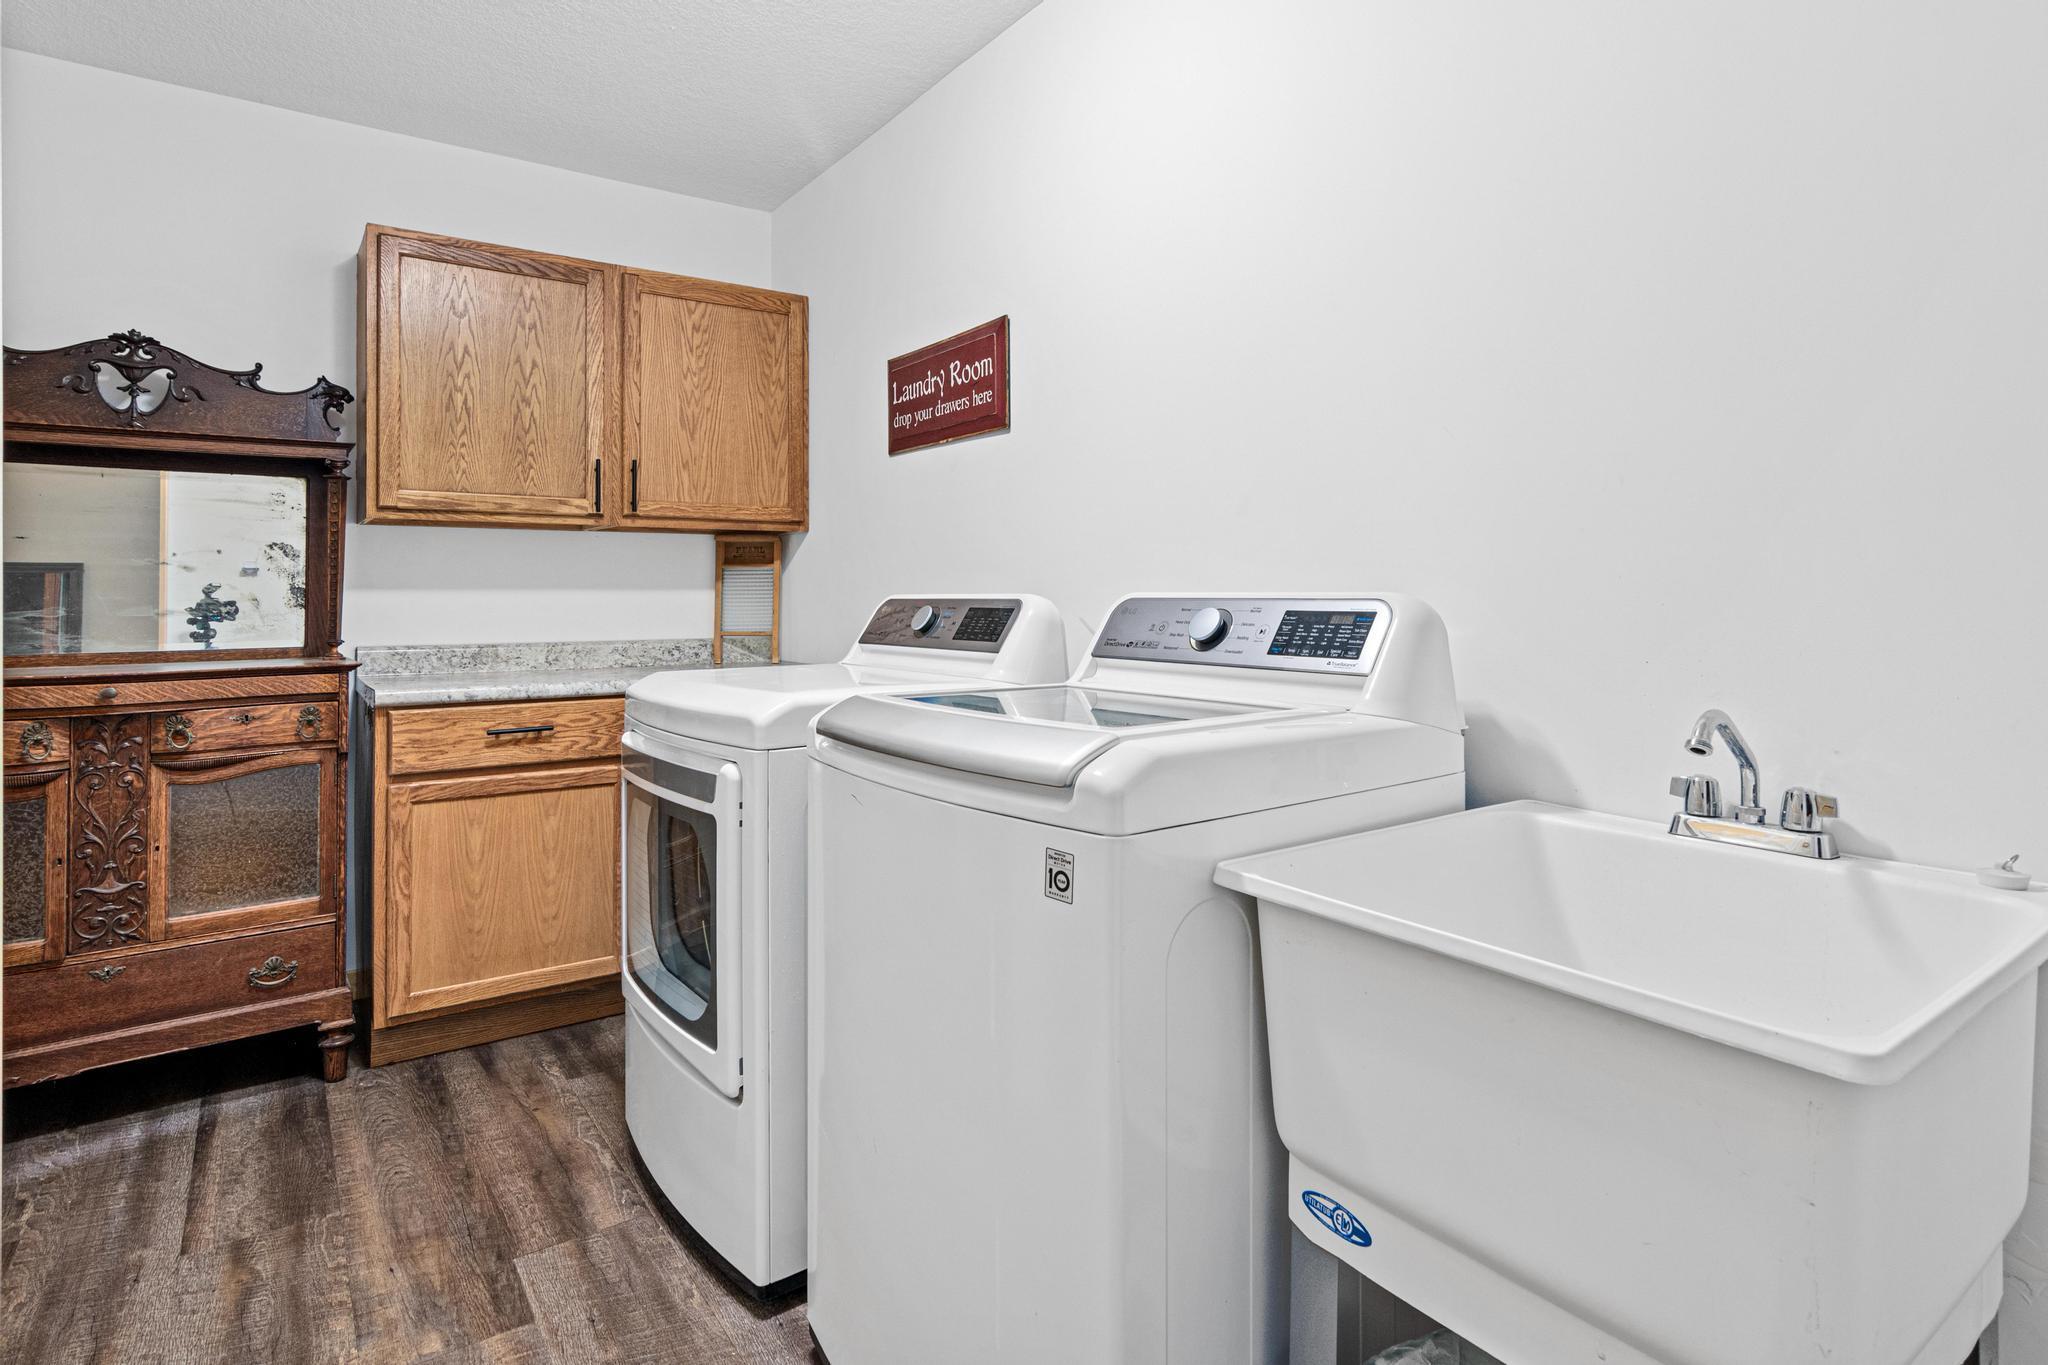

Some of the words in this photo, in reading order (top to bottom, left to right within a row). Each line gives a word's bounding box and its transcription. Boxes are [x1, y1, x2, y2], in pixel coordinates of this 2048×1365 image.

[893, 368, 945, 404] Laundry
[949, 356, 993, 387] Room
[893, 412, 912, 429] drop
[914, 406, 932, 427] your
[935, 397, 970, 416] drawers
[972, 388, 993, 407] here
[1048, 867, 1070, 893] 10
